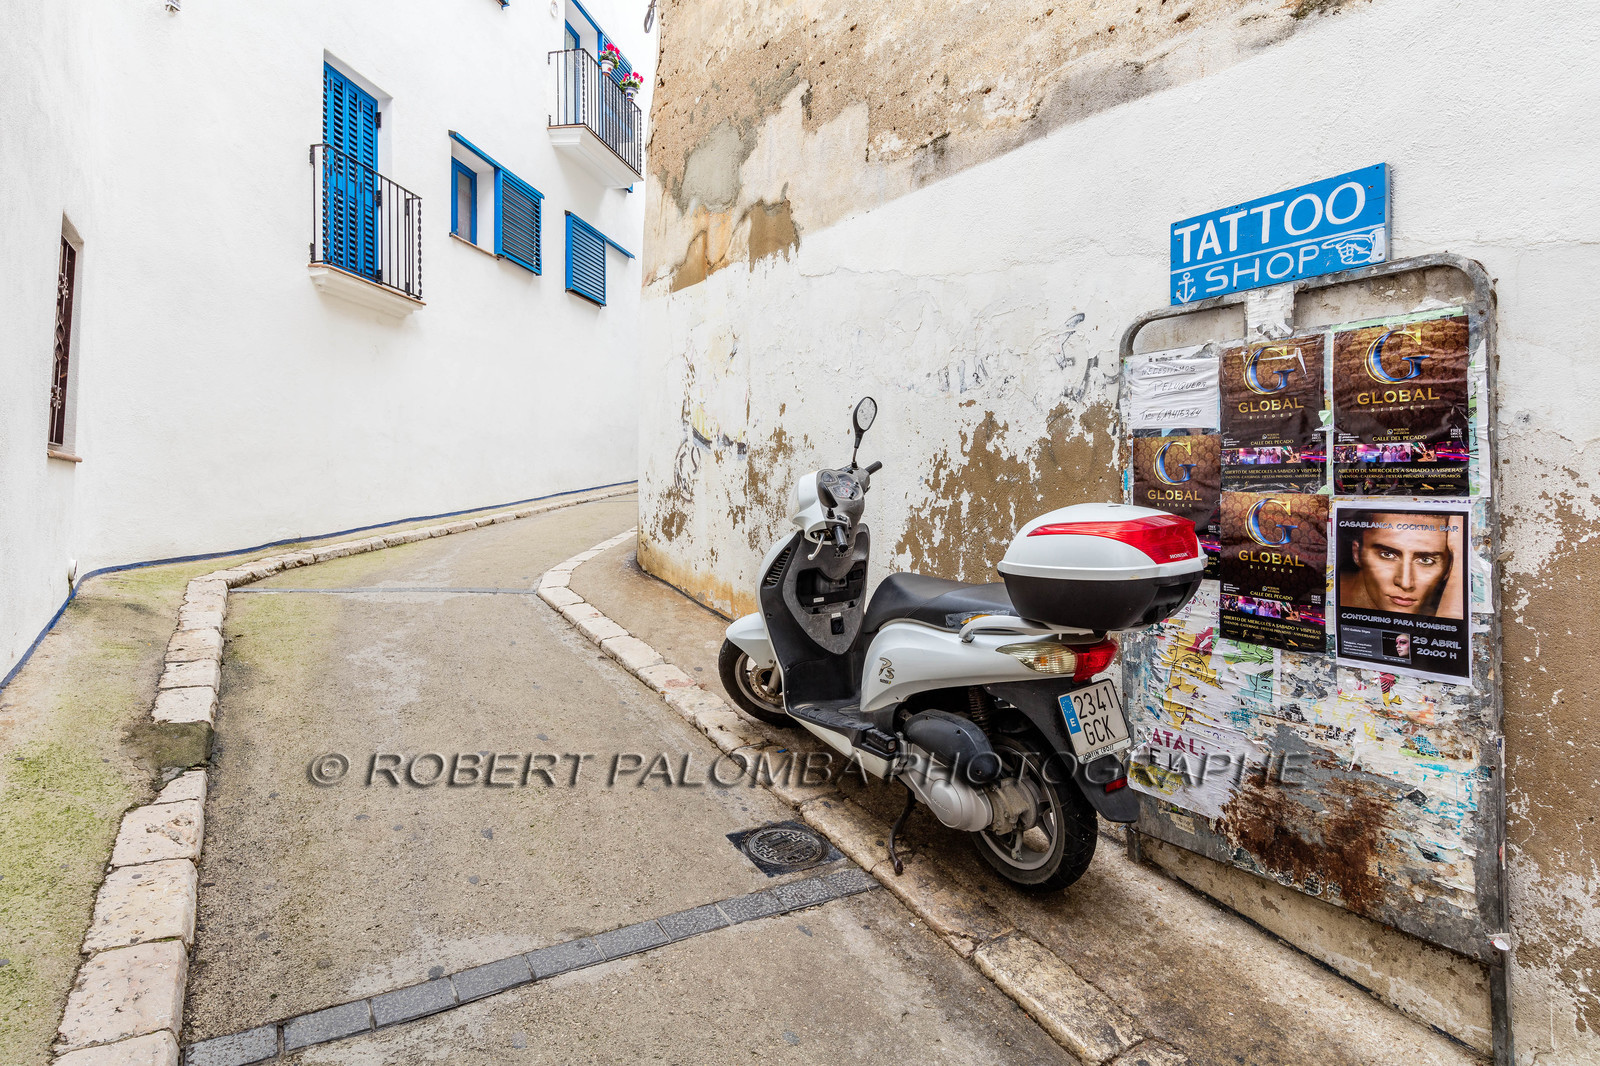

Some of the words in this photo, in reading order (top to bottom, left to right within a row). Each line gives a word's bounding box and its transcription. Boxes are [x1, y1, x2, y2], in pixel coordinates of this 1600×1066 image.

[1174, 181, 1366, 264] TATTOO
[1205, 245, 1319, 293] SHOP
[1238, 397, 1304, 413] GLOBAL
[1357, 387, 1440, 405] GLOBAL
[1147, 489, 1202, 501] GLOBAL
[1339, 520, 1394, 530] CASABLANCA
[1396, 523, 1437, 532] COCKTAIL
[1439, 524, 1459, 532] BAR
[1238, 550, 1305, 568] GLOBAL
[1341, 612, 1392, 624] CONTOURING
[1393, 618, 1414, 628] PARA
[1416, 622, 1458, 632] HOMBRES
[1412, 636, 1428, 645] 29
[1431, 638, 1462, 650] ABRIL
[1416, 647, 1447, 658] 20:00
[1449, 652, 1457, 660] H
[1073, 685, 1114, 720] 2341
[1069, 717, 1077, 727] E
[1083, 714, 1116, 746] GCK
